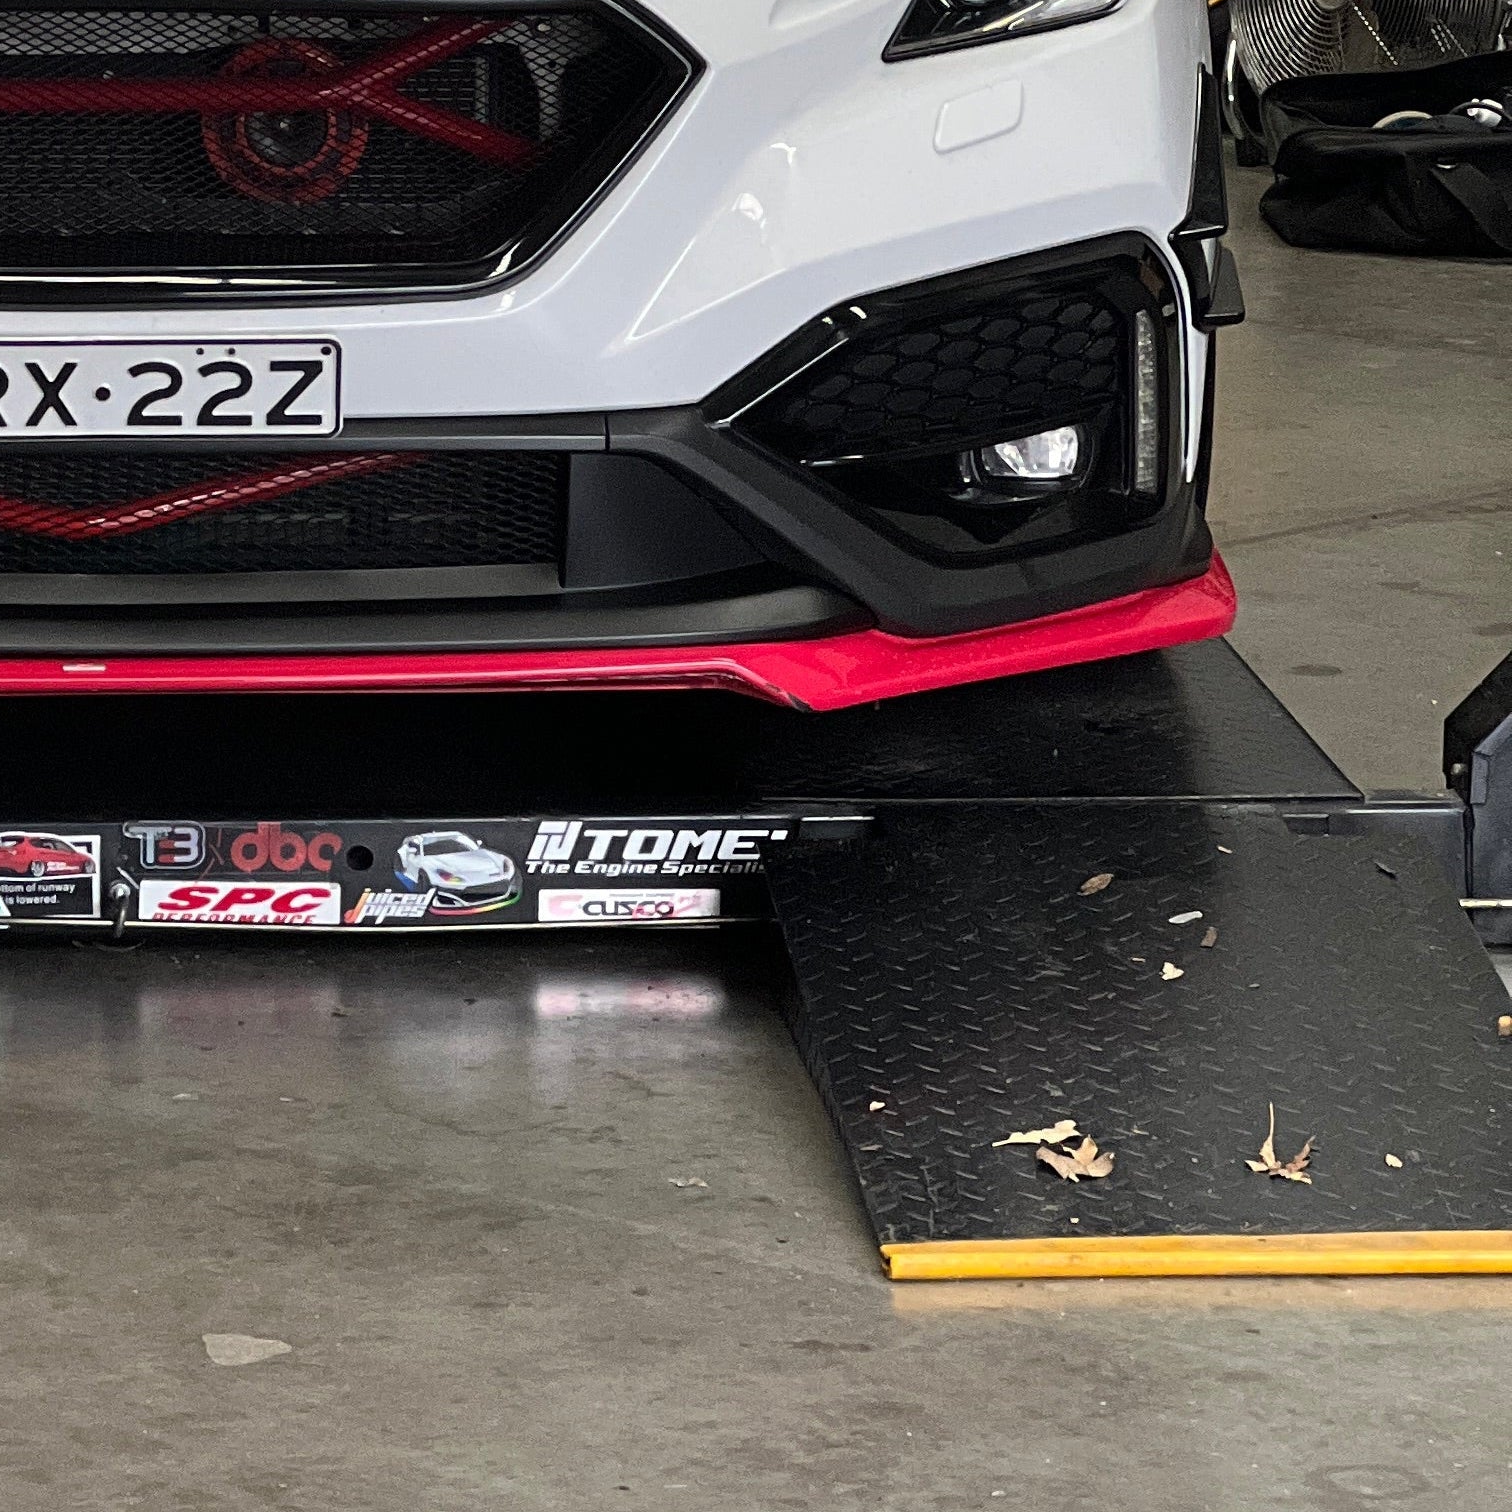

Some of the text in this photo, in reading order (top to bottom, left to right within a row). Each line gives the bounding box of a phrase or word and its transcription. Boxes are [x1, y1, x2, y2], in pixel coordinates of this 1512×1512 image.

[231, 821, 343, 873] dbc
[583, 829, 788, 860] TOME
[526, 860, 766, 877] The Engine Specialis
[26, 882, 36, 893] of
[38, 884, 76, 894] runway
[157, 886, 331, 913] SPC
[151, 911, 317, 925] PERFORMANCE
